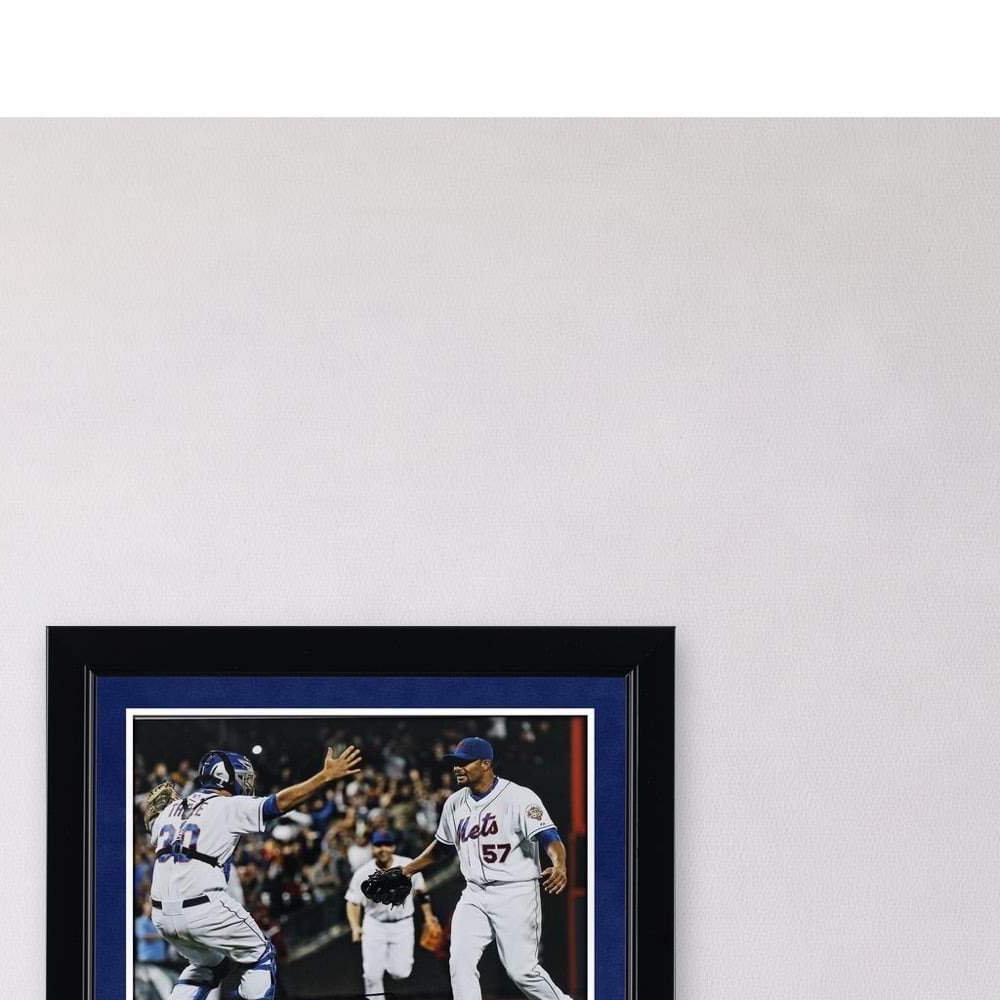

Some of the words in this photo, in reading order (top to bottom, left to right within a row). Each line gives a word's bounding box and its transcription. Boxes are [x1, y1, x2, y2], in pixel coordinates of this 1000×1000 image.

[168, 801, 208, 817] THE
[456, 812, 499, 843] Mets
[482, 843, 511, 864] 57
